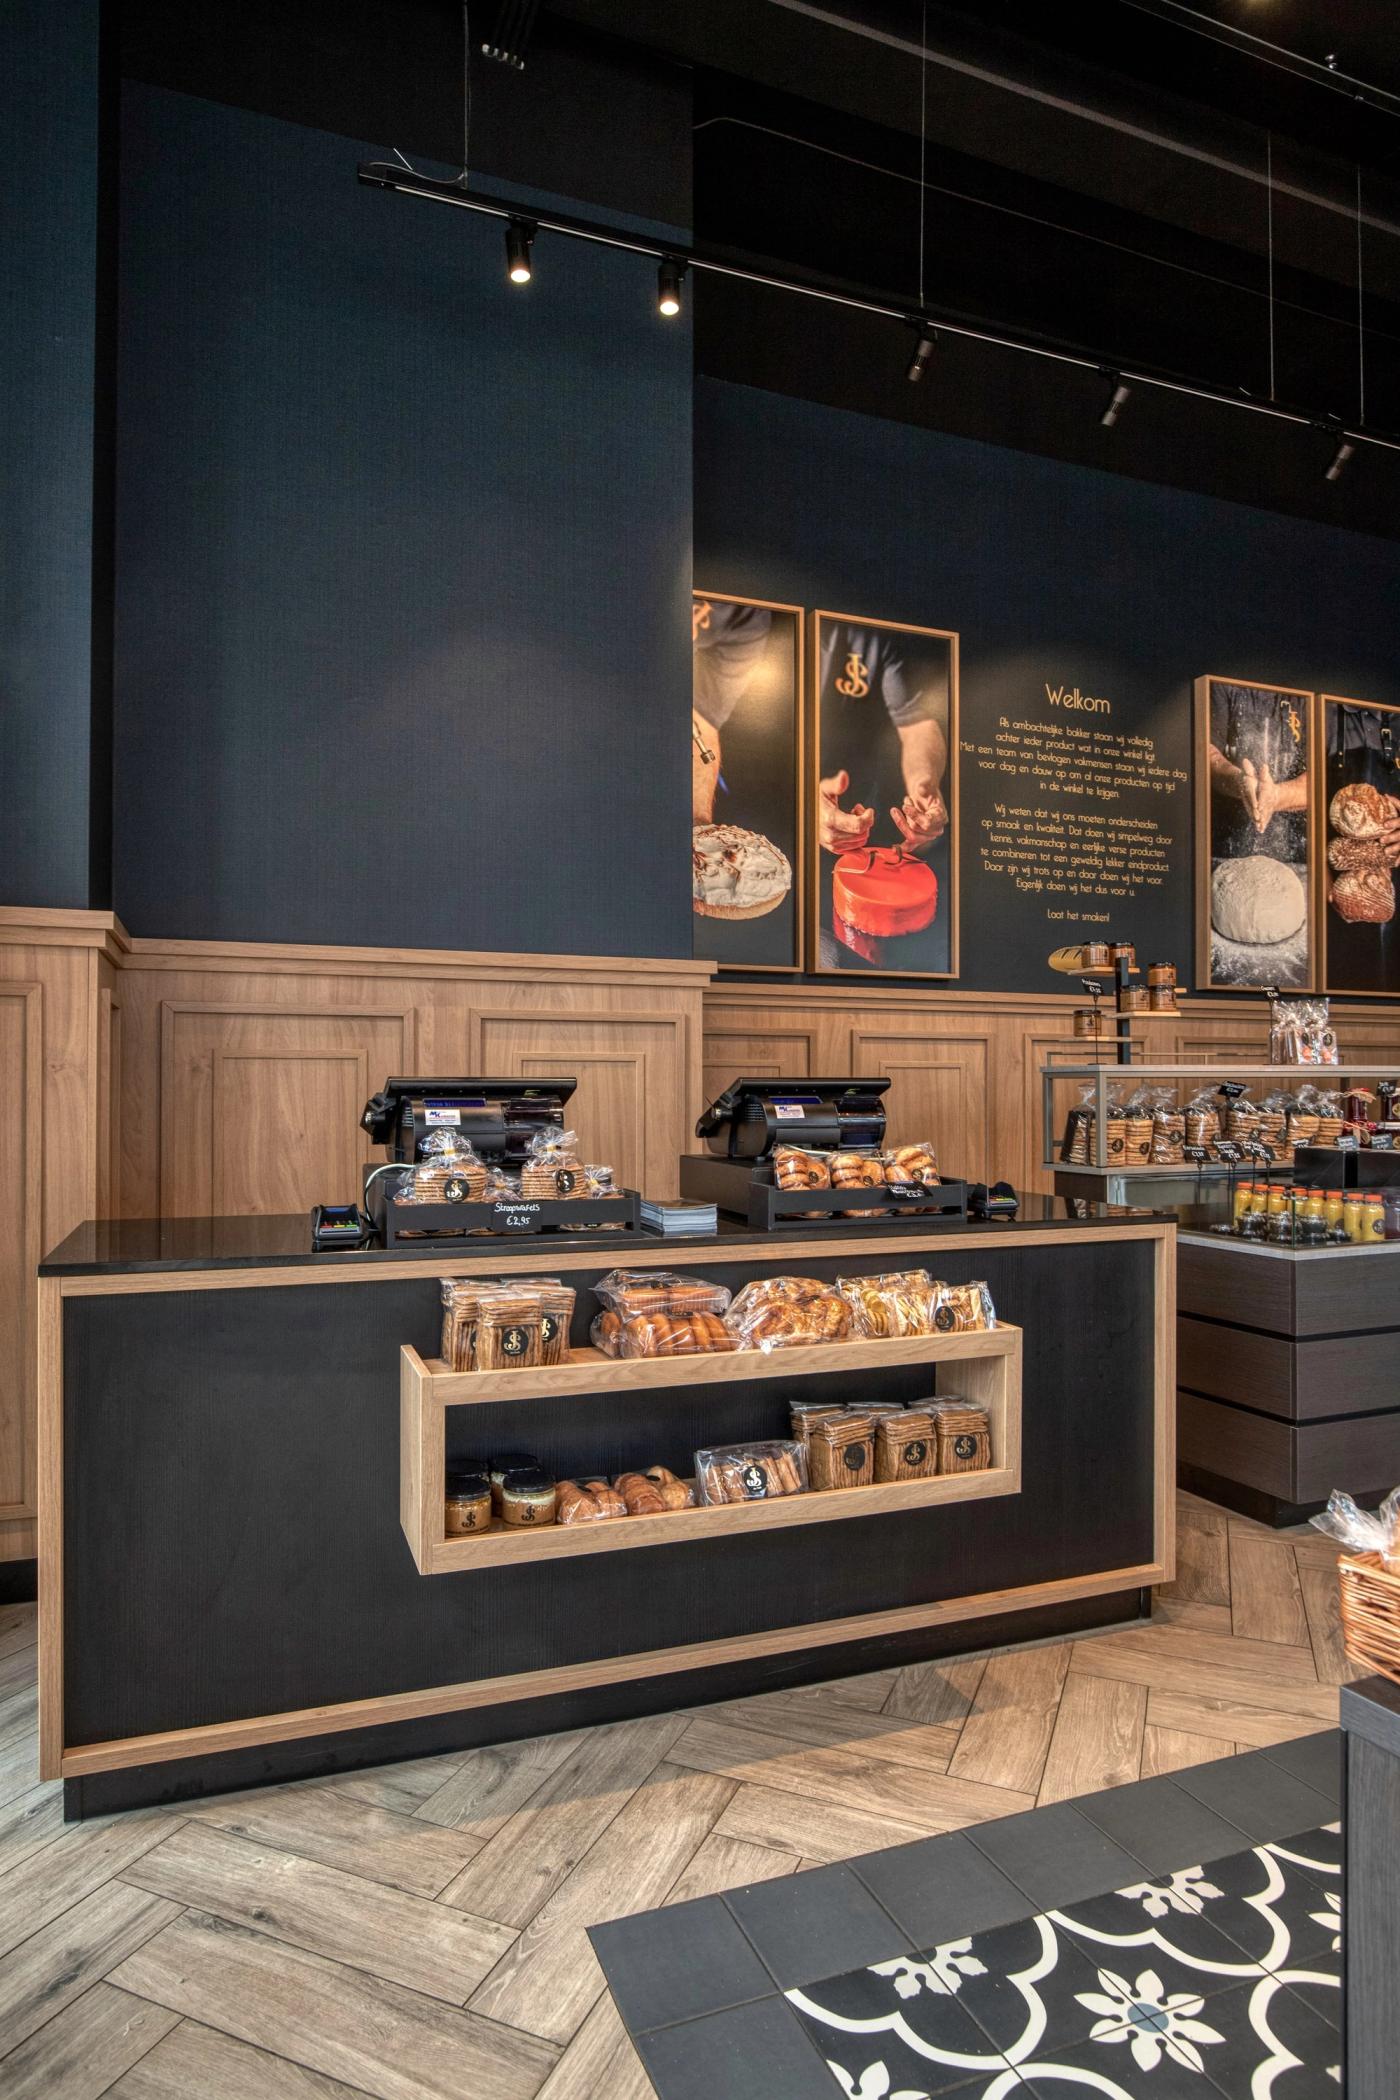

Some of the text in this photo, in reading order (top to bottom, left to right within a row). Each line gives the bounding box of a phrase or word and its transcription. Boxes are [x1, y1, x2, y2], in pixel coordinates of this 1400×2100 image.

[1045, 683, 1111, 714] Welkom
[995, 732, 1020, 744] achter
[1023, 736, 1042, 746] ieder
[1045, 739, 1074, 751] product
[1078, 744, 1092, 753] wat
[1103, 748, 1120, 757] onze
[1123, 750, 1143, 760] winkel
[999, 717, 1154, 750] Als ambachtelijke bakker staan wij volledig
[960, 741, 1188, 782] Met een team van bevlogen vakmensen staan wij iedere dag
[978, 761, 996, 769] voor
[999, 761, 1016, 775] dag
[1018, 766, 1030, 774] en
[1031, 765, 1052, 776] dauw
[1055, 771, 1067, 781] op
[1068, 771, 1082, 779] om
[1084, 771, 1092, 779] al
[1094, 774, 1112, 783] onze
[1113, 776, 1150, 788] producten
[1152, 782, 1163, 792] op
[1039, 781, 1047, 789] in
[1049, 781, 1060, 791] de
[1062, 783, 1084, 794] winkel
[1086, 786, 1094, 795] te
[994, 802, 1159, 830] Wij weten dat wij ons moeten onderscheiden
[981, 819, 993, 830] op
[995, 819, 1021, 830] smaak
[1023, 822, 1034, 831] en
[1068, 825, 1082, 836] Dat
[1084, 827, 1105, 838] doen
[1106, 831, 1116, 843] wij
[1118, 832, 1154, 847] simpelweg
[1155, 835, 1173, 845] door
[1016, 836, 1067, 851] vakmanschap
[1069, 842, 1080, 850] en
[1082, 841, 1106, 855] eerlijke
[1108, 845, 1128, 855] verse
[1129, 847, 1166, 858] producten
[980, 847, 990, 856] te
[992, 847, 1038, 860] combineren
[1040, 853, 1051, 861] tot
[1053, 855, 1068, 863] een
[1070, 855, 1103, 869] geweldig
[1105, 858, 1126, 868] lekker
[984, 860, 1004, 872] Daar
[1007, 864, 1019, 876] zijn
[1021, 866, 1031, 878] wij
[1033, 866, 1050, 876] trots
[1052, 869, 1064, 880] op
[1066, 870, 1077, 878] en
[1078, 869, 1097, 880] daar
[1099, 872, 1119, 881] doen
[1121, 875, 1131, 886] wij
[1132, 874, 1144, 883] het
[1016, 877, 1044, 893] Eigenlijk
[1046, 881, 1067, 892] doen
[1068, 884, 1078, 895] wij
[1080, 883, 1093, 893] het
[1094, 884, 1108, 895] dus
[1110, 887, 1127, 896] voor
[1047, 908, 1065, 920] Laat
[1066, 910, 1080, 920] het
